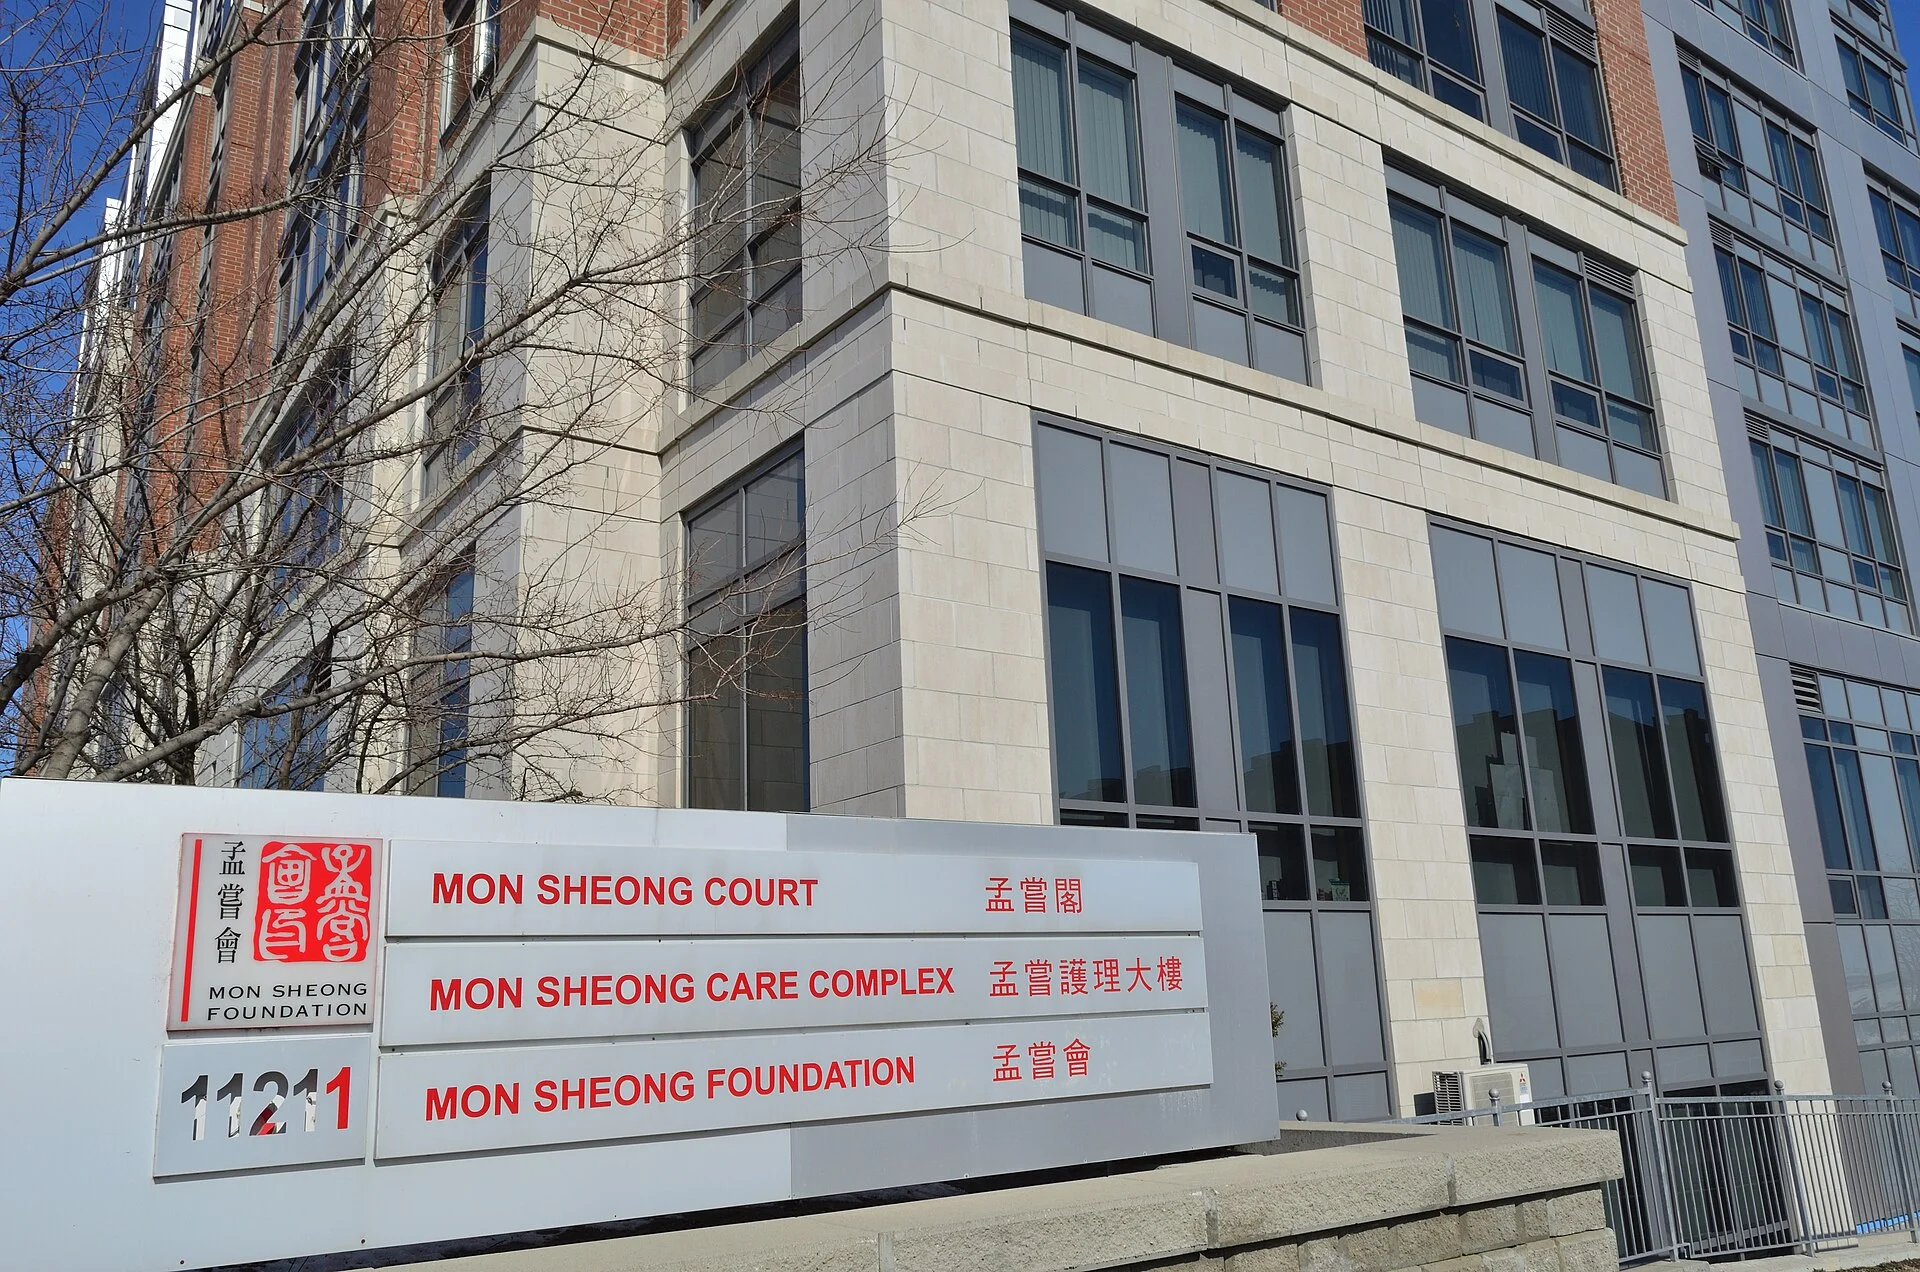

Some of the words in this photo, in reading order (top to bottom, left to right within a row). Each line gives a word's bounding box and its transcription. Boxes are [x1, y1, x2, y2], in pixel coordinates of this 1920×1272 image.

[433, 872, 523, 905] MON
[537, 874, 693, 906] SHEONG
[704, 877, 818, 907] COURT
[985, 877, 1083, 914] 孟嘗閣
[209, 985, 261, 1000] MON
[272, 983, 367, 998] SHEONG
[430, 977, 523, 1011] MON
[536, 973, 695, 1008] SHEONG
[706, 970, 799, 1002] CARE
[808, 967, 955, 998] COMPLEX
[989, 955, 1183, 997] 孟嘗護理大樓
[207, 1003, 367, 1021] FOUNDATION
[992, 1038, 1092, 1083] 孟嘗會
[181, 1067, 351, 1140] 11211
[425, 1082, 520, 1121] MON
[533, 1071, 695, 1113] SHEONG
[707, 1055, 915, 1100] FOUNDATION
